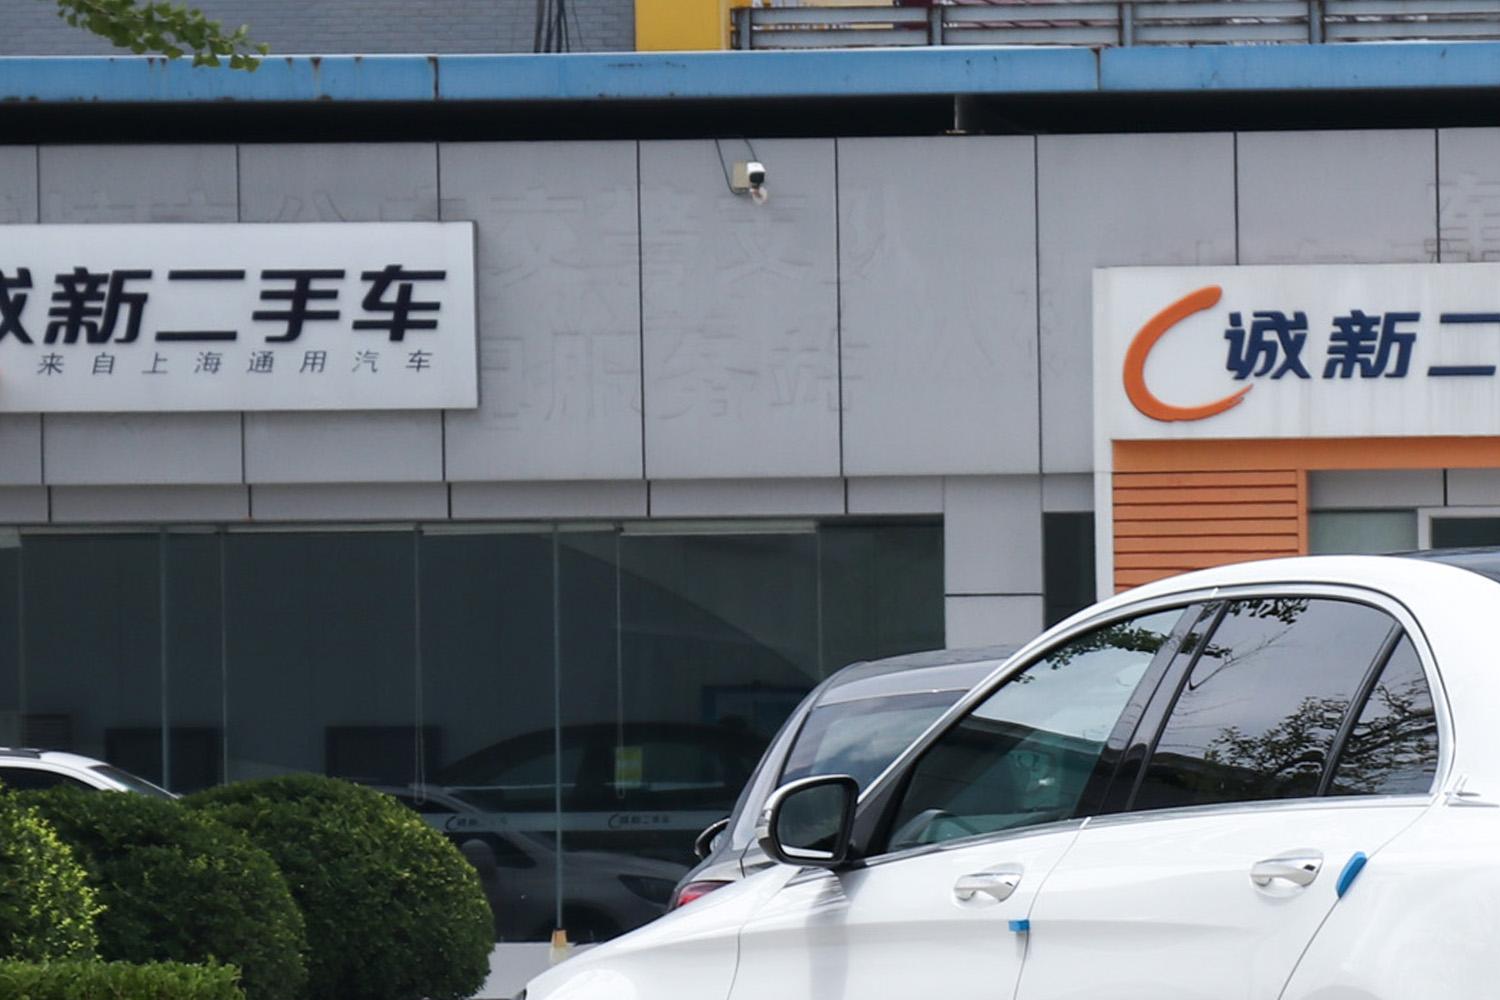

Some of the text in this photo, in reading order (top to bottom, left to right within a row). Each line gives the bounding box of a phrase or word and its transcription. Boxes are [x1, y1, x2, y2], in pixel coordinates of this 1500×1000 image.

[37, 349, 434, 376] 来自上海通用汽车
